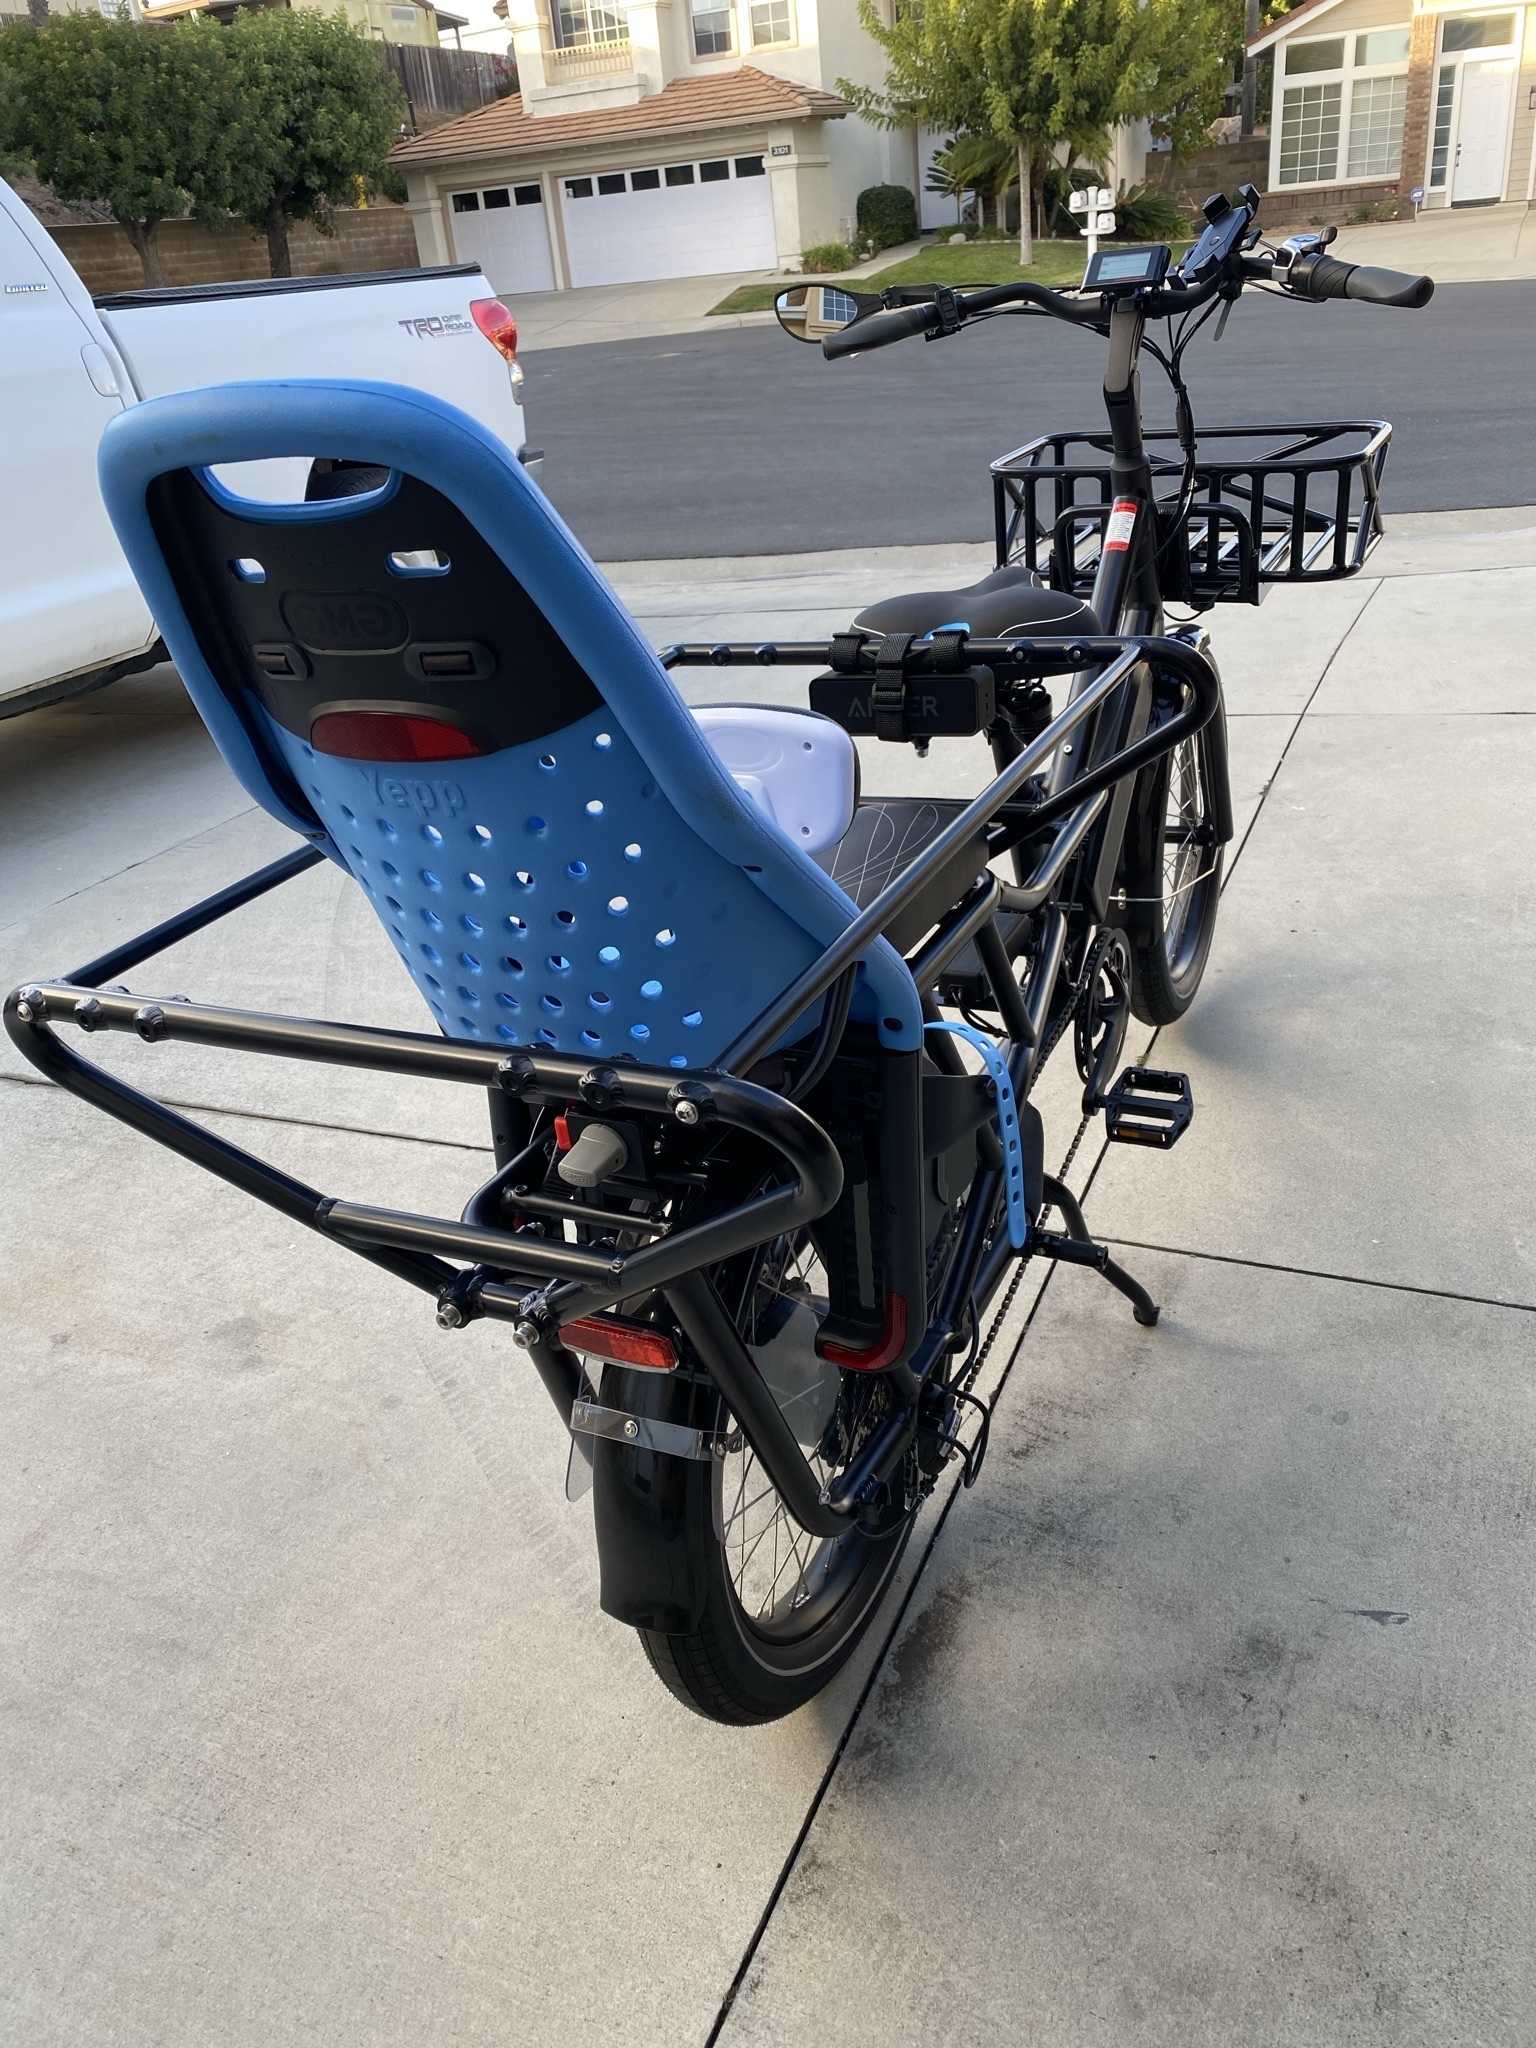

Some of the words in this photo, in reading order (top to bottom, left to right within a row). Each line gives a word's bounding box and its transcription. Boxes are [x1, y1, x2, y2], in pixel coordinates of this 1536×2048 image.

[398, 316, 444, 339] TRD
[442, 314, 462, 322] OFF
[445, 321, 473, 332] ROAD
[847, 695, 940, 718] AER
[359, 768, 468, 818] Yepp
